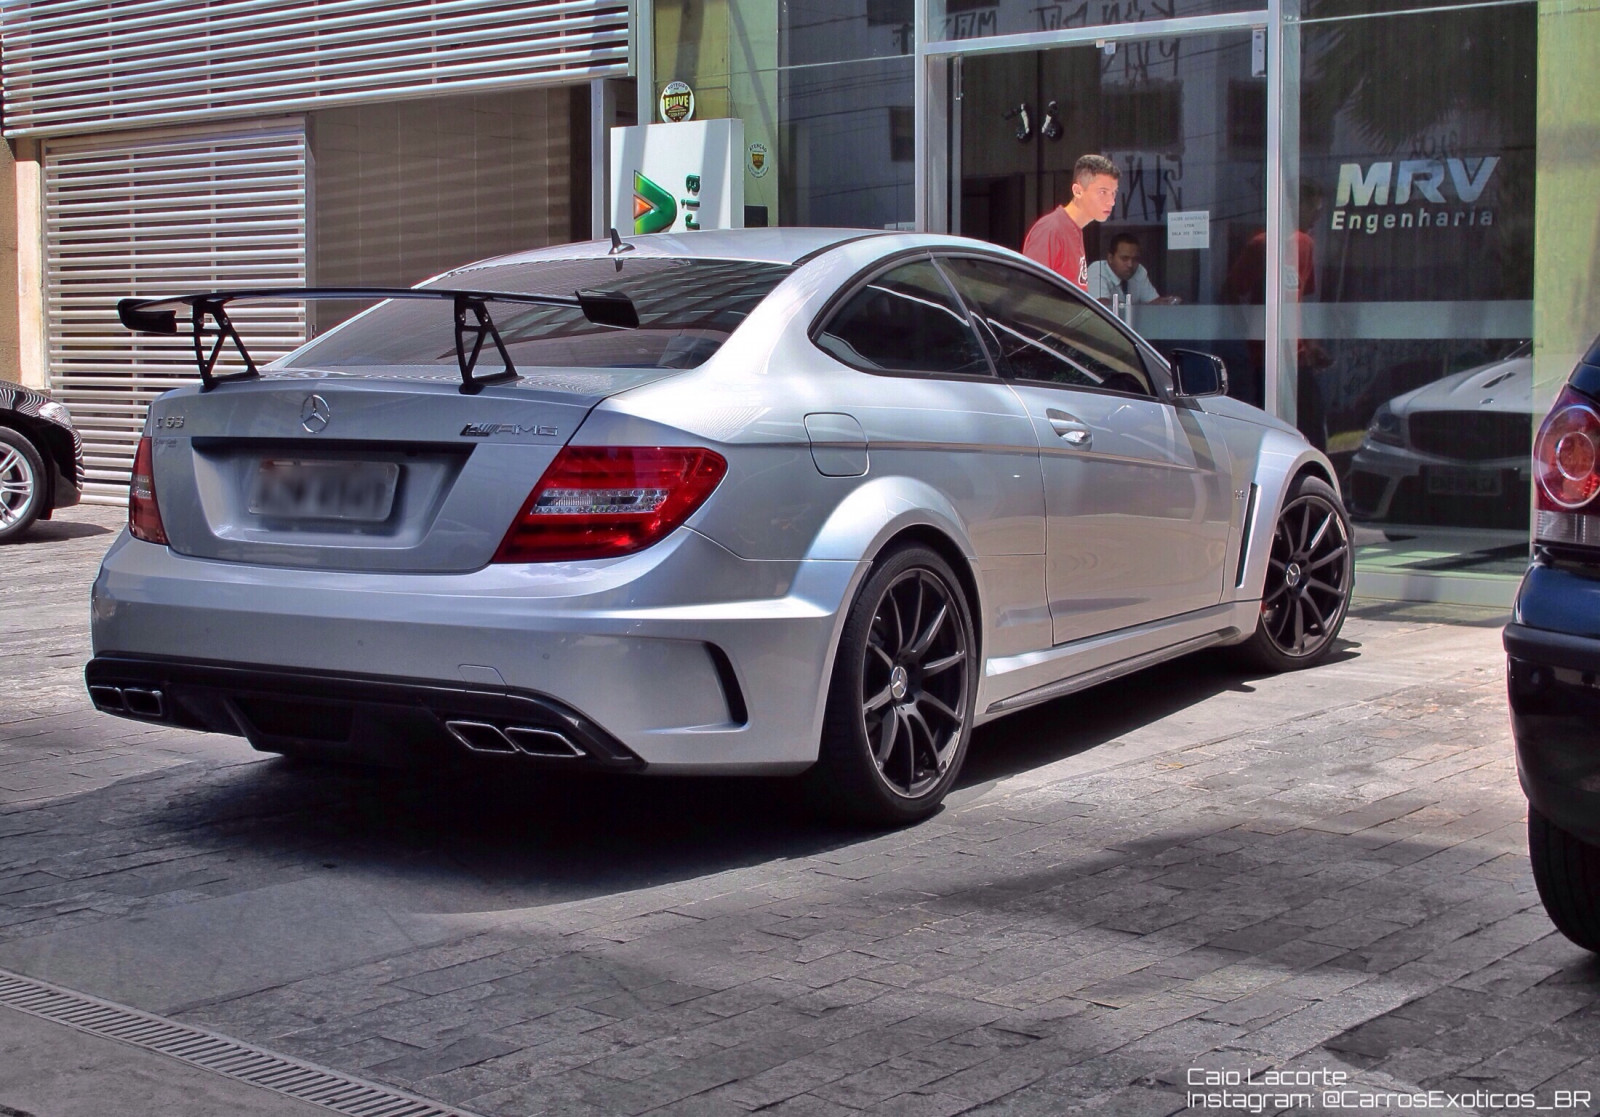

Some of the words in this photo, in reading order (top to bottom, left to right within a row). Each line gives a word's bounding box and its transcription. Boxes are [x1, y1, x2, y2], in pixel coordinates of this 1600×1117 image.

[1335, 156, 1501, 207] MRV
[1331, 207, 1493, 234] Engenharia
[166, 415, 185, 429] 63
[496, 423, 558, 437] AMG
